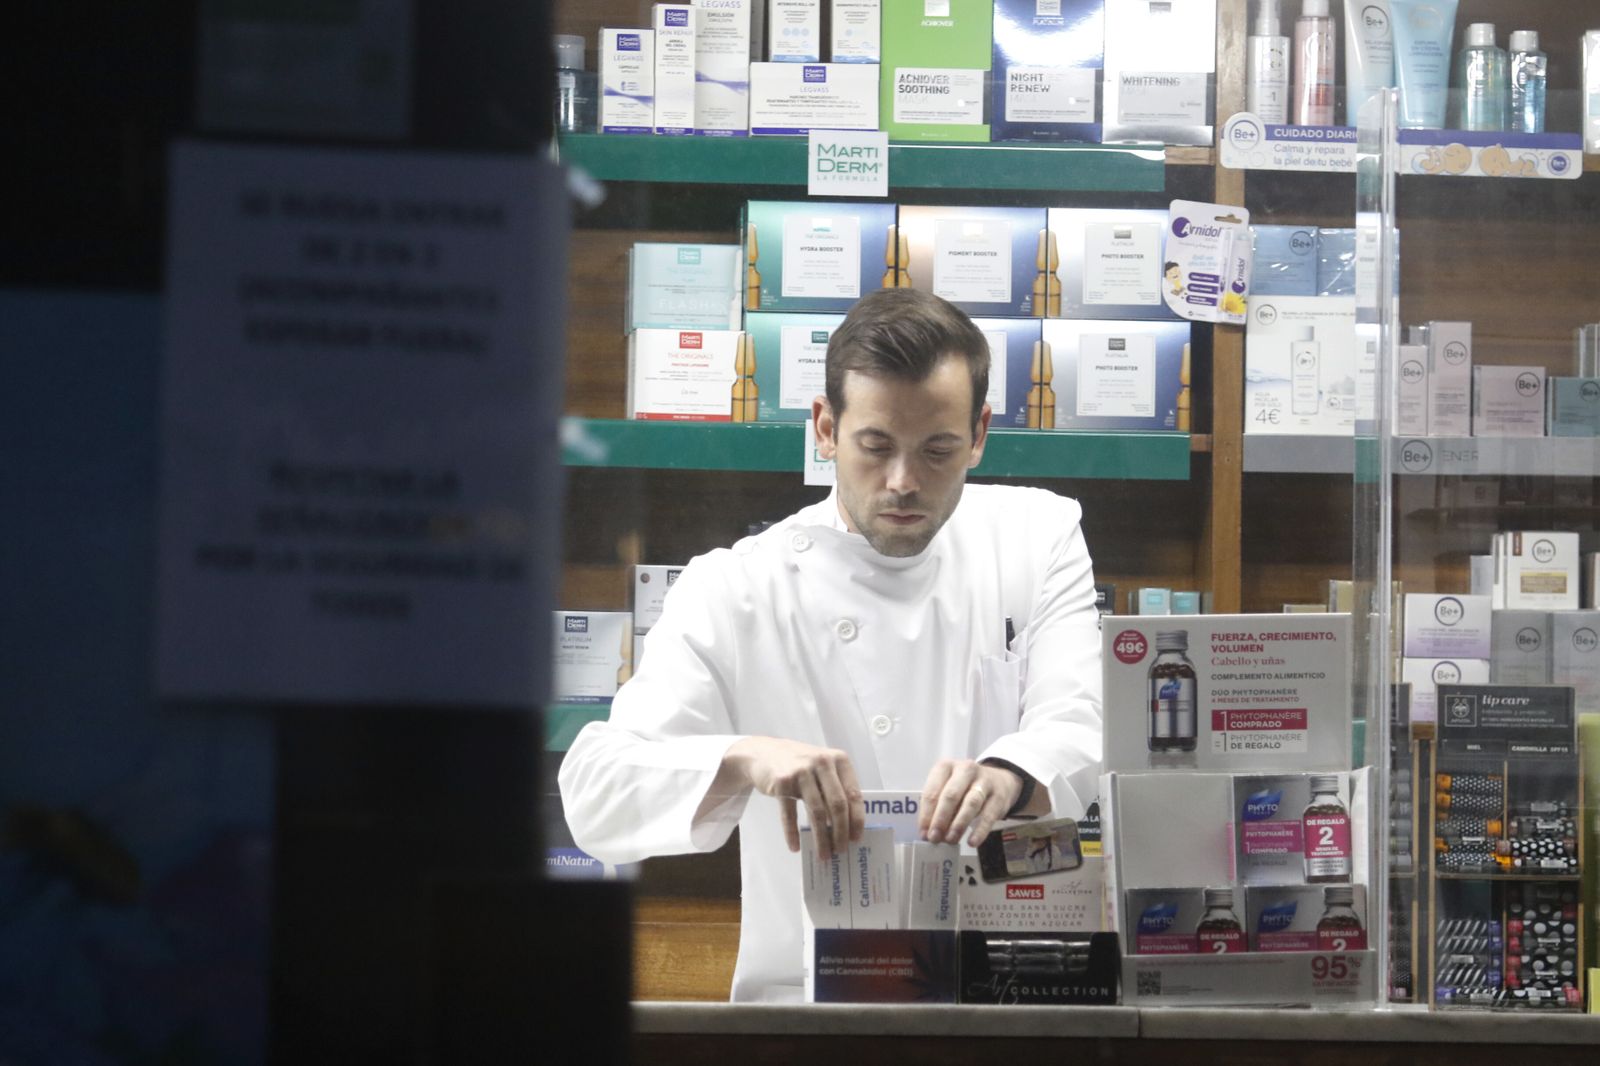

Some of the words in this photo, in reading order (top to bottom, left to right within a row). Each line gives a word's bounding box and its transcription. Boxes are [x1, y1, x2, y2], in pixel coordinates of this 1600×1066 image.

[701, 1, 742, 9] LEGVASS
[1010, 73, 1044, 82] NIGHT
[1121, 76, 1181, 87] WHITENING
[898, 84, 950, 94] SOOTHING
[1010, 84, 1051, 93] RENEW
[1274, 128, 1325, 138] CUIDADO
[817, 143, 879, 158] MARTI
[1273, 144, 1305, 154] Calma
[1315, 146, 1345, 157] repara
[1274, 156, 1282, 165] la
[1284, 156, 1302, 168] piel
[1182, 221, 1222, 238] Arnidol
[1446, 349, 1465, 358] Be+
[1402, 368, 1421, 377] Be+
[1518, 379, 1538, 389] Be+
[1255, 408, 1282, 425] 4€
[1403, 450, 1430, 463] Be+
[1211, 632, 1258, 643] FUERZA,
[1259, 631, 1337, 642] CRECIMIENTO,
[1116, 641, 1145, 654] 49€
[1211, 643, 1264, 653] VOLUMEN
[1211, 655, 1251, 666] Cabello
[1261, 655, 1286, 666] uñas
[1211, 672, 1273, 681] COMPLEMENTO
[1274, 672, 1326, 680] ALIMENTICIO
[1501, 697, 1530, 706] care
[1230, 720, 1282, 729] COMPRADO
[1244, 741, 1281, 749] REGALO
[1247, 803, 1279, 812] PHYTO
[1317, 818, 1345, 826] REGALO
[1319, 826, 1335, 846] 2
[859, 846, 871, 908] Calmmabis
[940, 859, 955, 921] Calmmabis
[1007, 889, 1042, 898] SAWES
[1200, 932, 1210, 941] DE
[1211, 932, 1240, 941] REGALO
[1319, 930, 1330, 938] DE
[1331, 929, 1360, 938] REGALO
[819, 956, 844, 965] Alivio
[844, 956, 875, 966] natural
[876, 956, 889, 966] del
[819, 968, 834, 976] con
[1009, 986, 1109, 995] COLLECTION
